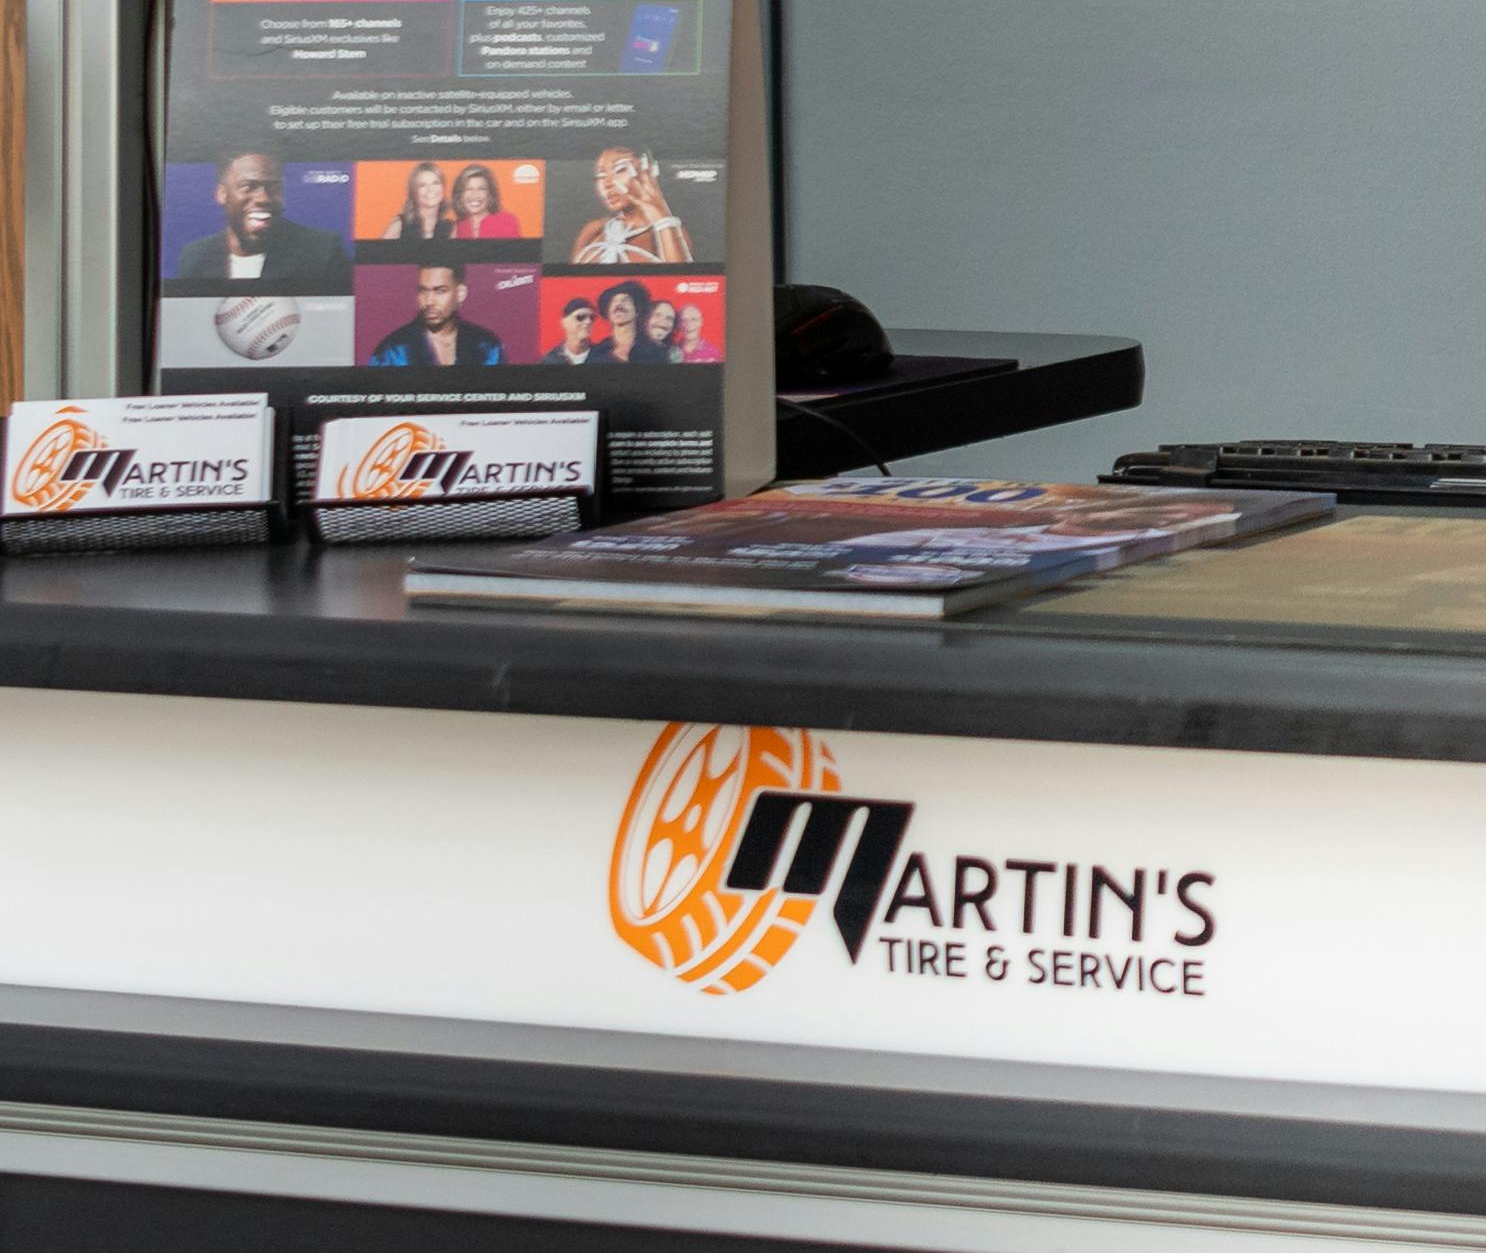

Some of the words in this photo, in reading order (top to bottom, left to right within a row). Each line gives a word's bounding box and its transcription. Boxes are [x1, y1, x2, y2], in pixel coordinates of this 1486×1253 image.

[486, 5, 515, 16] Enjoy
[545, 5, 591, 15] channels
[260, 19, 300, 30] Choose
[302, 19, 328, 29] from
[355, 18, 402, 28] channels
[515, 21, 540, 31] your
[260, 33, 283, 44] and
[284, 33, 328, 44] SiriusXM
[330, 33, 381, 44] exclusives
[382, 33, 399, 43] like
[469, 33, 493, 44] plus
[545, 32, 606, 43] customized
[292, 49, 337, 59] Howard
[338, 49, 367, 59] Stern
[480, 45, 527, 56] Pandora
[528, 45, 571, 56] stations
[572, 45, 593, 55] and
[502, 59, 546, 69] demand
[547, 59, 587, 69] content
[333, 90, 380, 100] Available
[381, 92, 396, 100] on
[397, 90, 438, 100] inactive
[269, 105, 308, 117] Eligible
[309, 105, 363, 115] customers
[364, 104, 382, 114] will
[384, 105, 398, 114] be
[399, 104, 452, 114] contacted
[453, 104, 467, 115] by
[515, 104, 546, 113] either
[547, 103, 562, 115] by
[562, 104, 593, 113] email
[273, 121, 287, 130] to
[288, 120, 304, 130] set
[305, 121, 321, 130] up
[322, 120, 346, 129] their
[347, 120, 369, 129] free
[369, 119, 390, 129] trial
[390, 120, 454, 130] subscription
[455, 120, 466, 128] in
[466, 120, 485, 129] the
[485, 120, 503, 128] car
[503, 119, 526, 128] and
[526, 120, 539, 128] on
[540, 119, 560, 128] the
[412, 135, 431, 144] See
[431, 134, 462, 143] Details
[307, 394, 367, 405] COURTESY
[369, 394, 384, 404] OF
[384, 393, 416, 404] YOUR
[416, 393, 464, 403] SERVICE
[463, 392, 507, 403] CENTER
[507, 392, 532, 402] AND
[532, 391, 587, 402] SIRIUSXM
[60, 448, 249, 498] MARTIN'S
[399, 450, 582, 496] MARTIN'S
[119, 487, 151, 499] TIRE
[159, 486, 171, 498] &
[176, 483, 244, 498] SERVICE
[725, 789, 1218, 967] MARTIN'S
[879, 937, 968, 979] TIRE
[985, 945, 1012, 982] &
[1027, 948, 1207, 998] SERVICE
